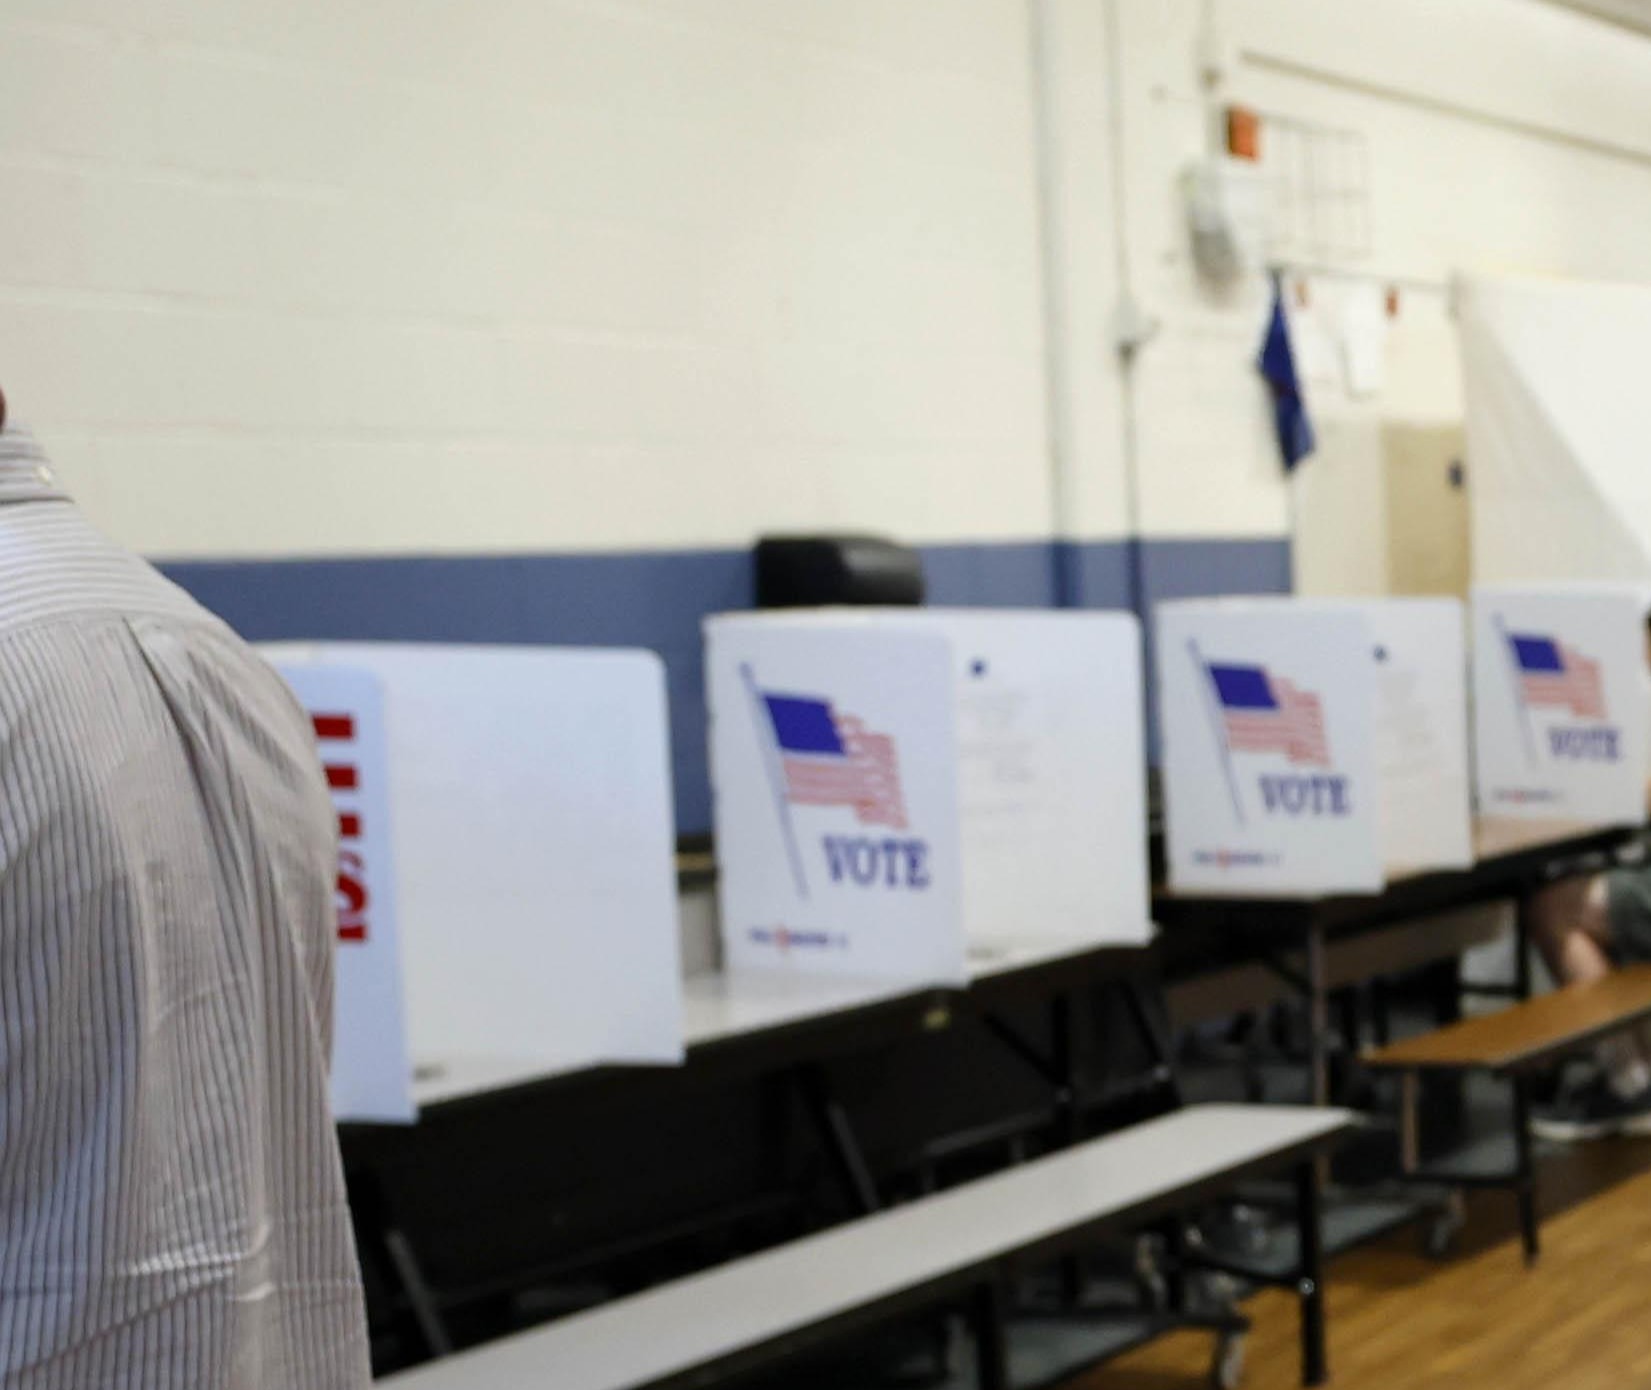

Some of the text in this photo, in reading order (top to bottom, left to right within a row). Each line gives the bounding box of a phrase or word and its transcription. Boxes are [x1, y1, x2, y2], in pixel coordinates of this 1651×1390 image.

[1546, 726, 1622, 762] VOTE
[1259, 773, 1352, 816] VOTE
[821, 835, 931, 889] VOTE
